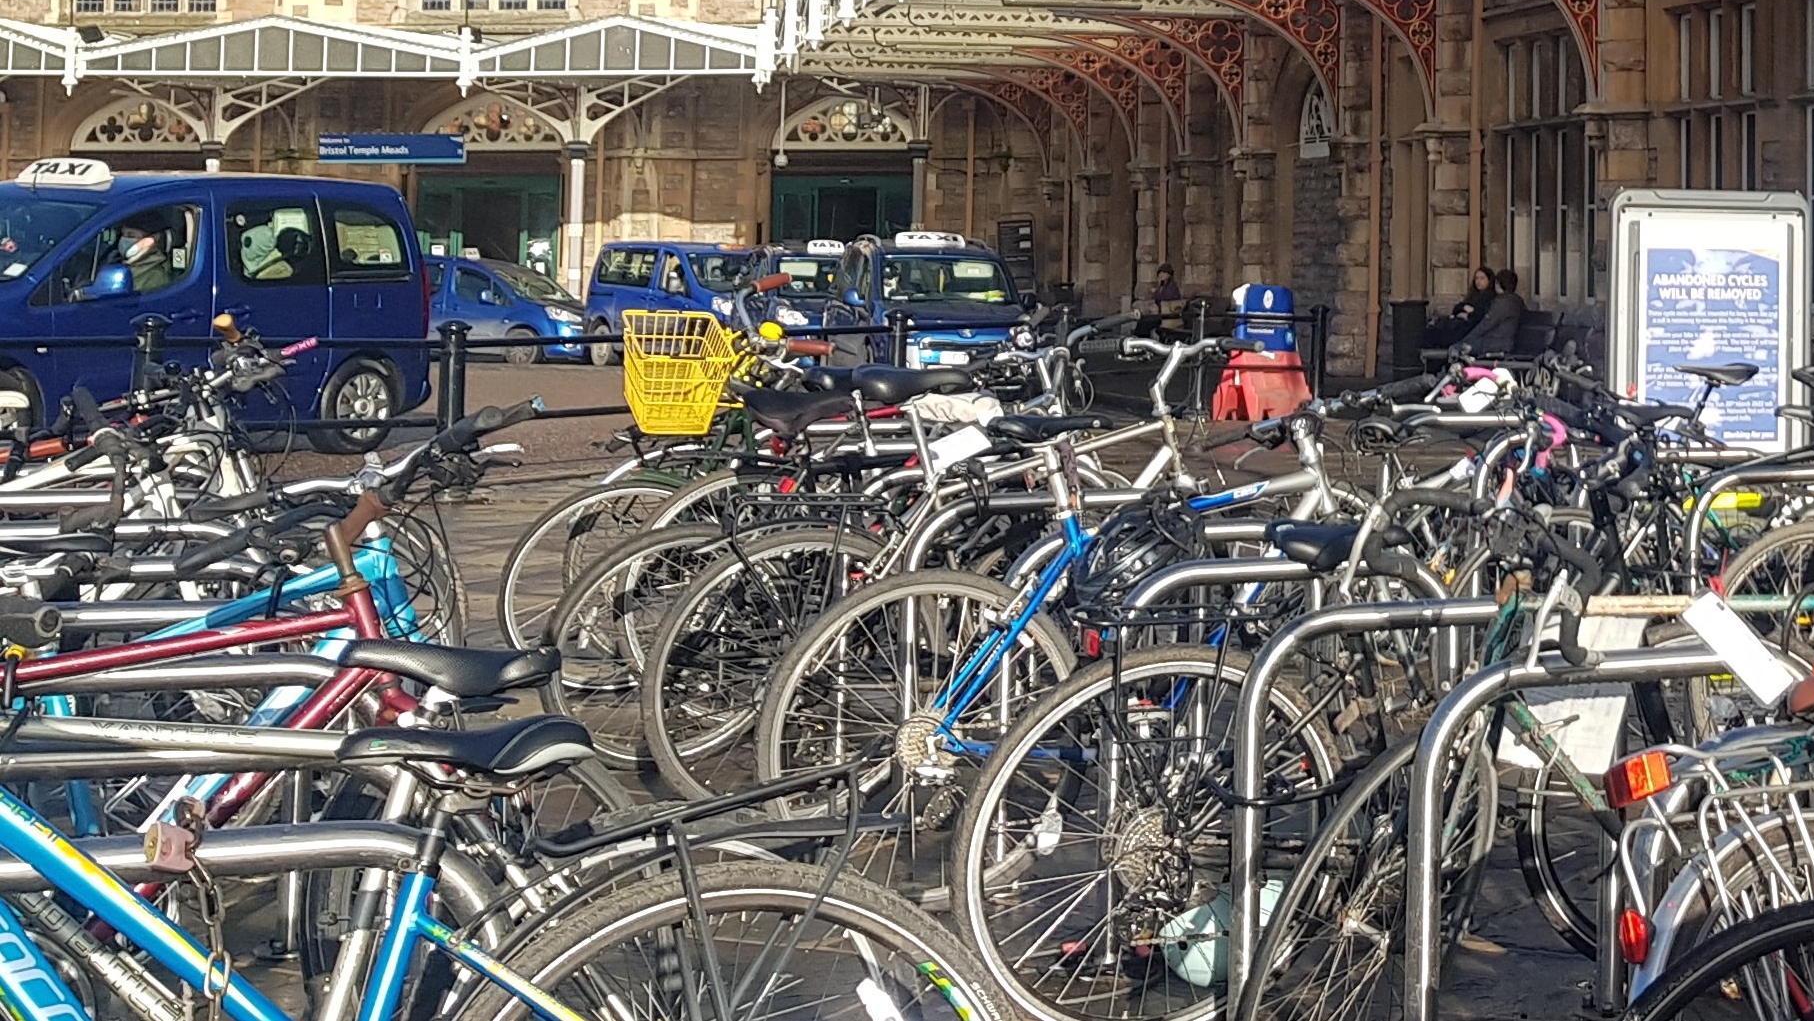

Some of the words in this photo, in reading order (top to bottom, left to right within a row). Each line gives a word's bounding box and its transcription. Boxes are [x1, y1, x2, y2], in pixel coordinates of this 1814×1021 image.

[319, 145, 347, 155] Bristol
[349, 145, 379, 156] Temple
[381, 145, 409, 155] Meads
[32, 163, 93, 175] TAXI
[903, 234, 958, 242] TAXI
[1653, 274, 1726, 286] ABANDONED
[1727, 274, 1768, 287] CYCLES
[1659, 287, 1688, 299] WILL
[1690, 288, 1705, 299] BE
[1707, 288, 1762, 300] REMOVED
[970, 981, 1002, 1021] SCHWA
